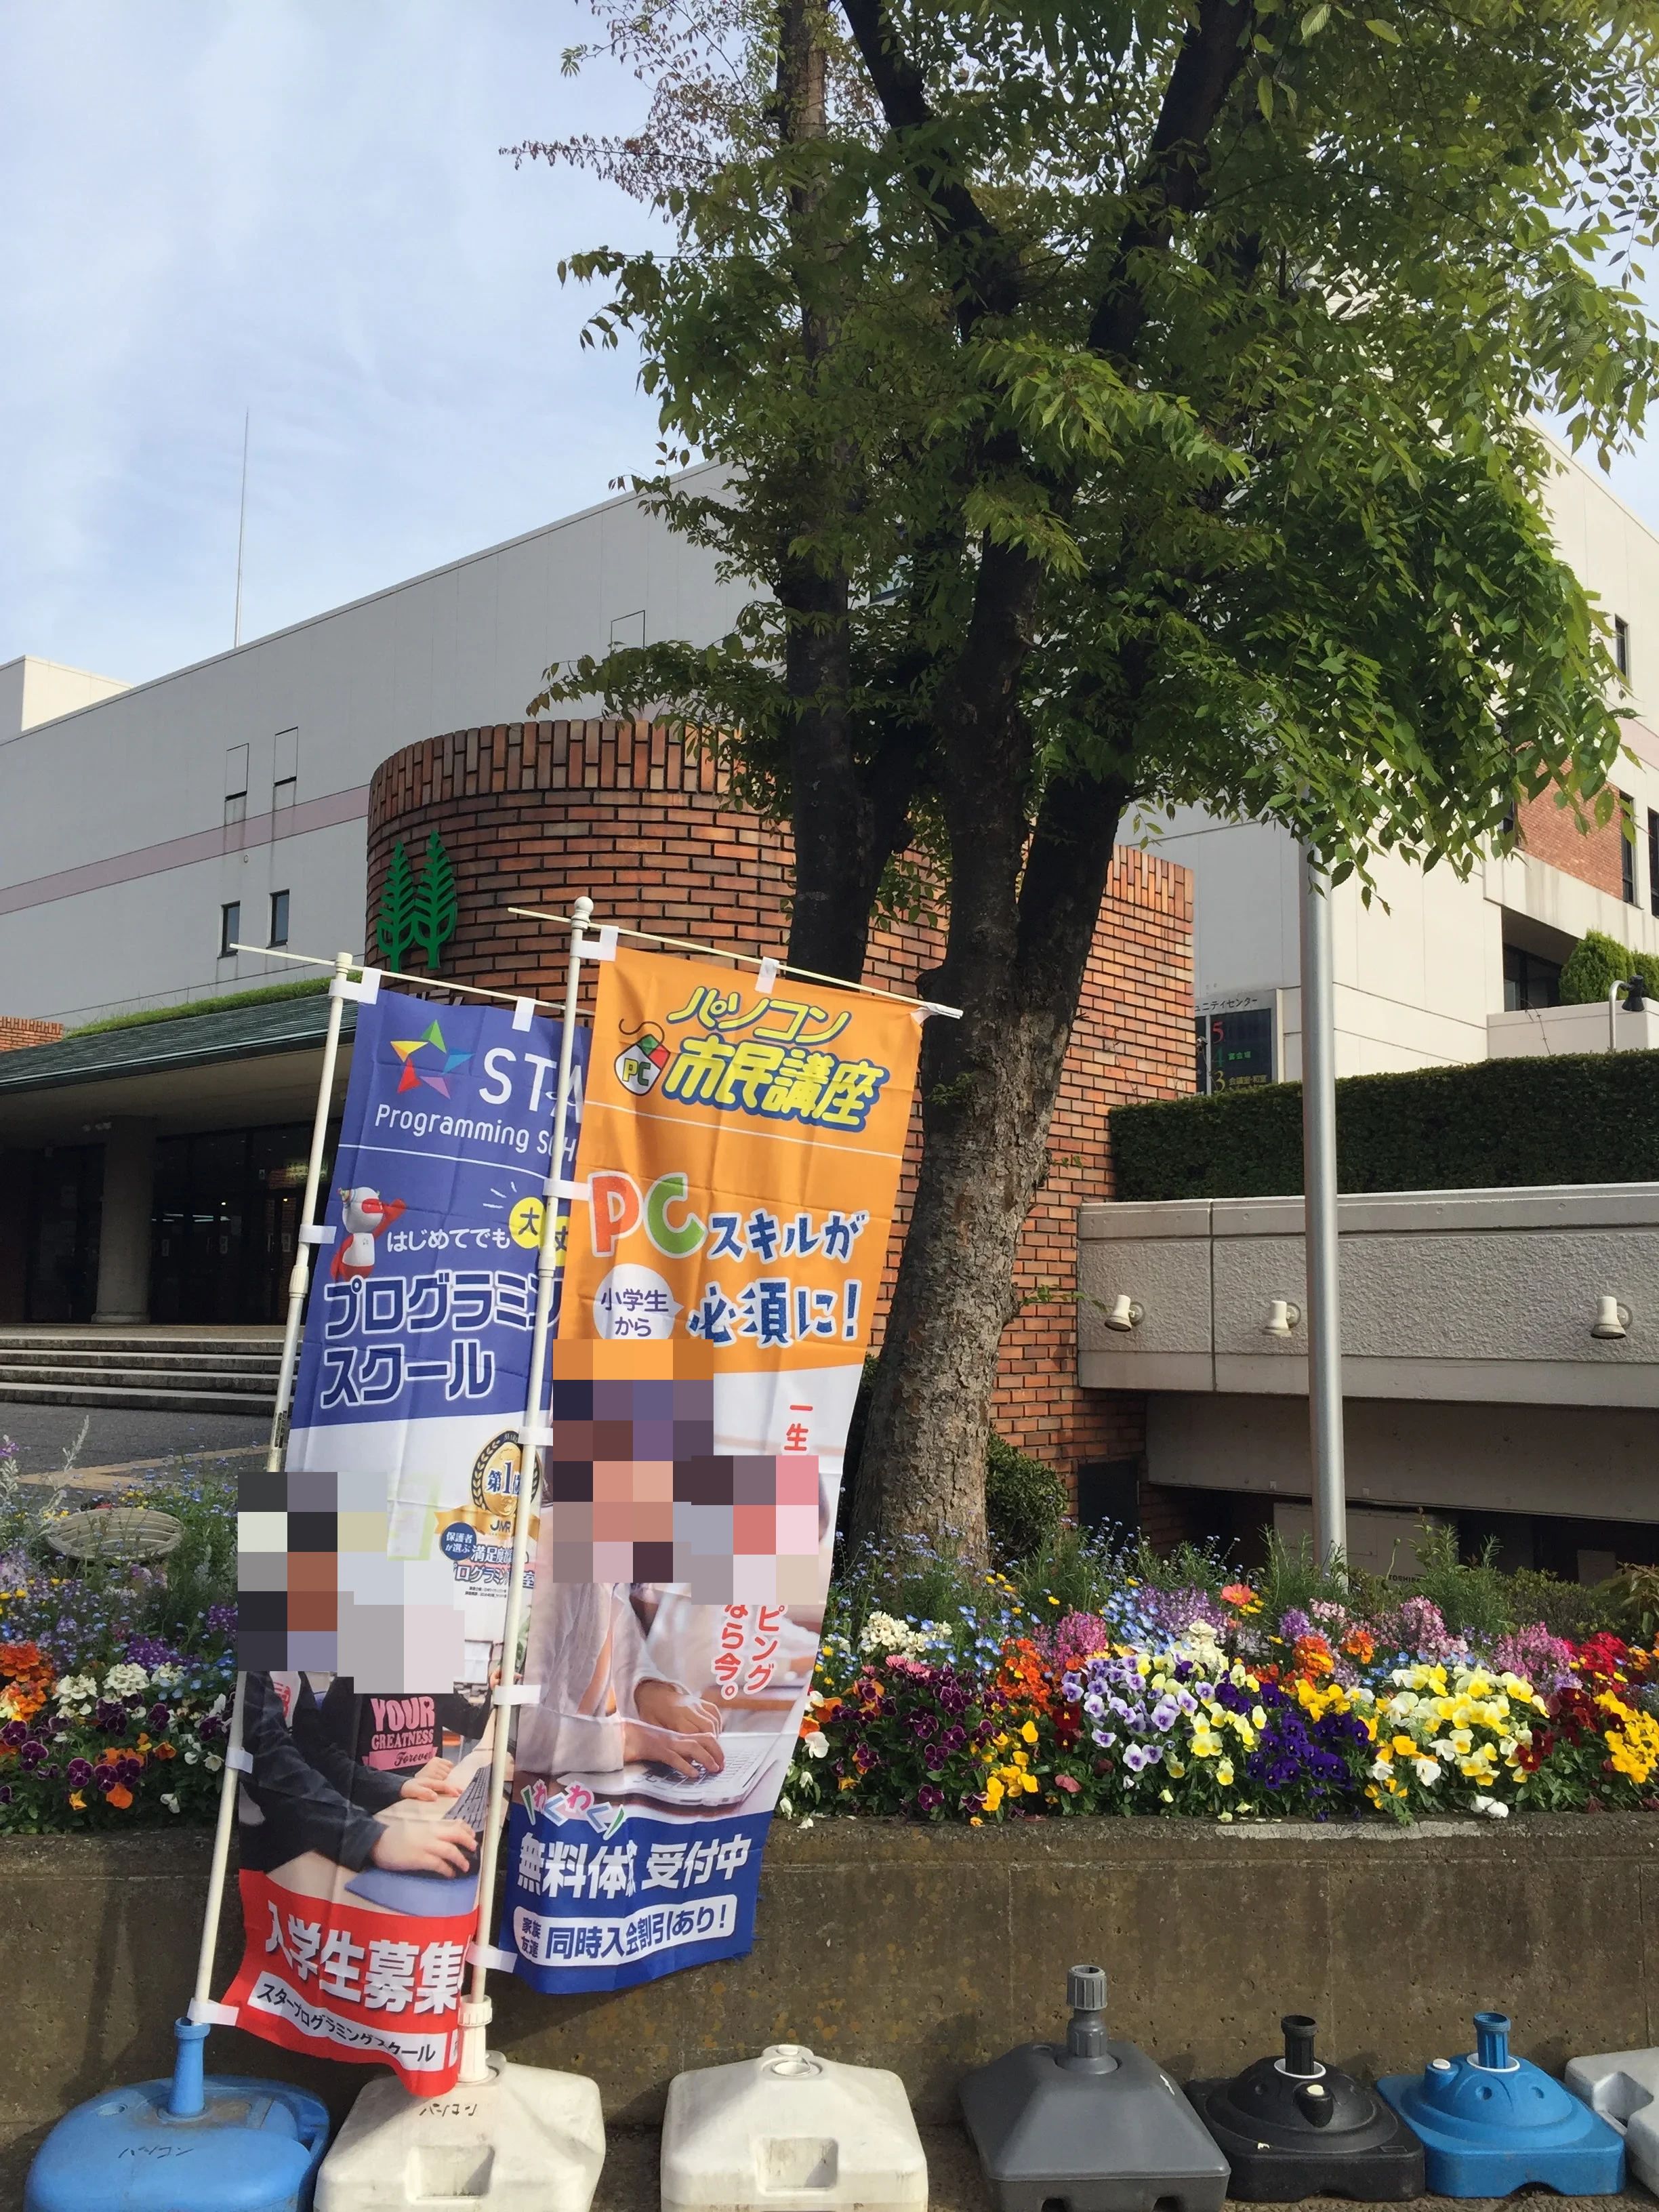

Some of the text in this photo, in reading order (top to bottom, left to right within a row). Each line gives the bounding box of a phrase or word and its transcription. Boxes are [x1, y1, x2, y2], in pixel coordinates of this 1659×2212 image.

[667, 985, 851, 1044] パソコン
[1212, 1021, 1225, 1044] 5
[622, 1057, 652, 1088] PC
[663, 1033, 889, 1132] 市民講座
[1213, 1070, 1225, 1093] 3
[374, 1103, 529, 1153] Programming
[387, 1227, 511, 1254] はじめてでも
[601, 1287, 669, 1314] 小学生
[688, 1277, 862, 1348] 必須に！
[614, 1316, 651, 1338] から
[321, 1338, 495, 1410] スクール
[446, 1532, 474, 1543] 保護者
[490, 1519, 512, 1533] JMR
[371, 1696, 435, 1732] YOUR
[371, 1729, 434, 1750] GREATNESS
[531, 1781, 611, 1833] わくわく
[517, 1832, 752, 1900] 無料体受付中
[522, 1917, 541, 1939] 家族
[265, 1900, 464, 2014] 入学生募集
[520, 1936, 539, 1959] 友達
